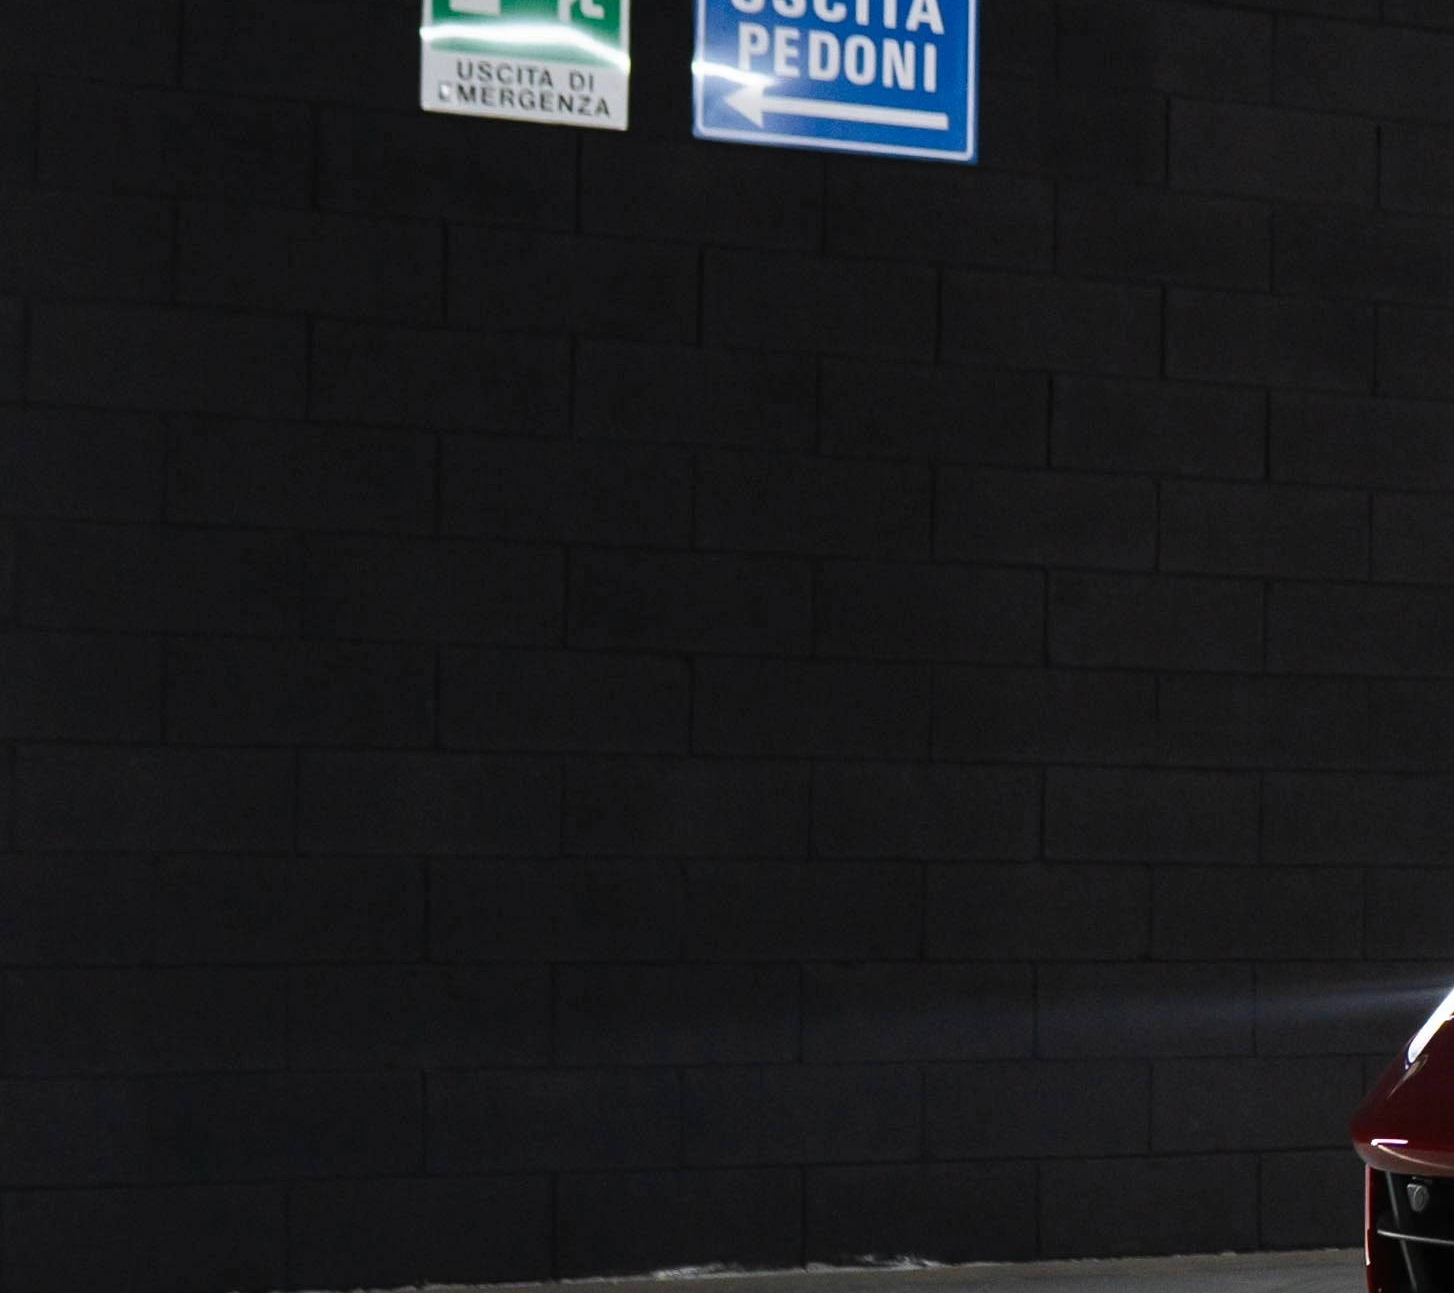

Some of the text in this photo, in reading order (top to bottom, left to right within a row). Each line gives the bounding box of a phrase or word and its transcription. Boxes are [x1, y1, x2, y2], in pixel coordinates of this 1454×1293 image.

[457, 58, 594, 92] USCITA DI
[738, 22, 937, 94] PEDONI
